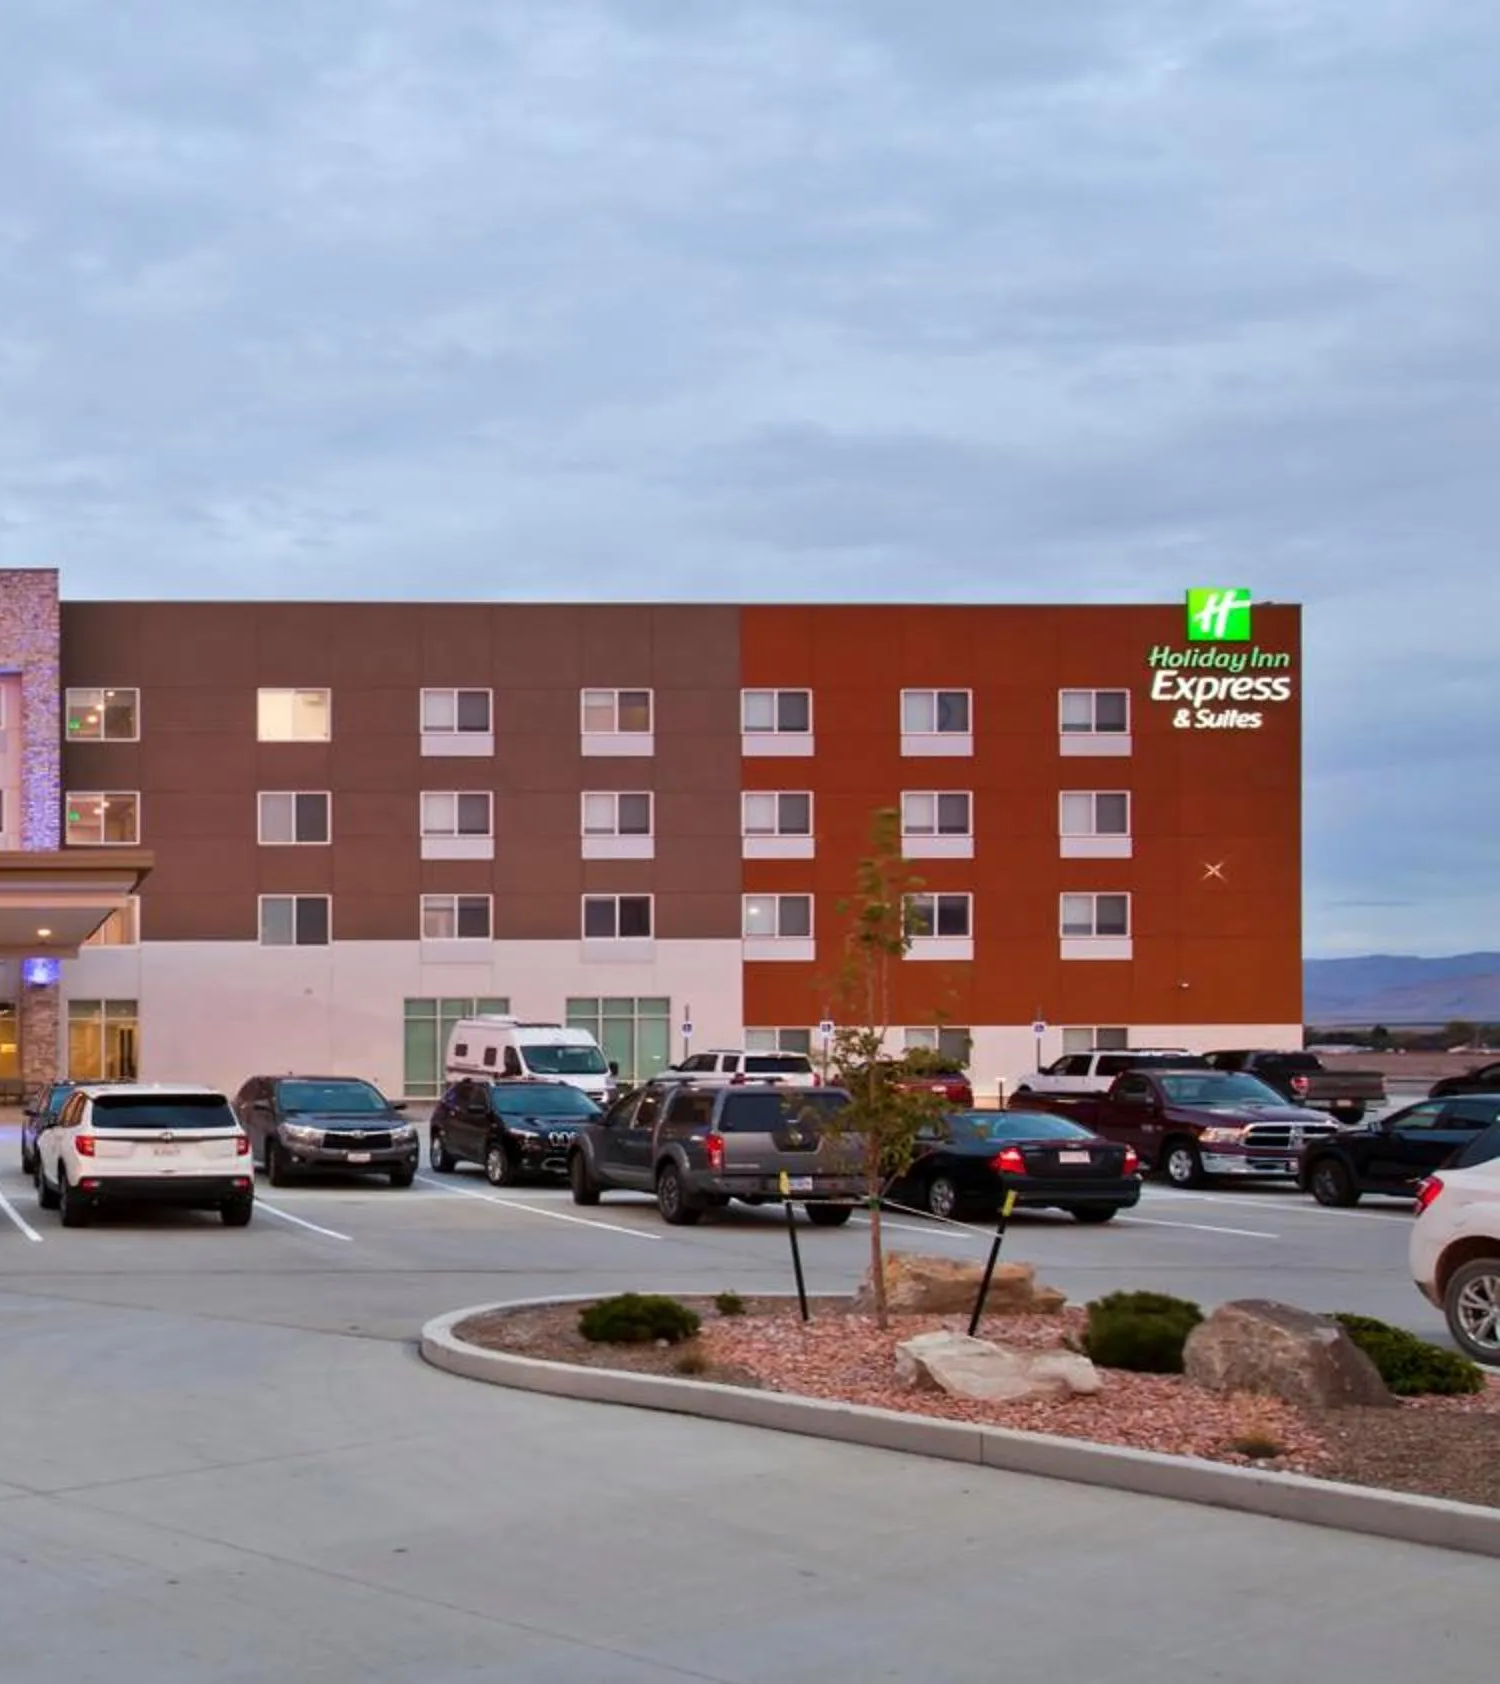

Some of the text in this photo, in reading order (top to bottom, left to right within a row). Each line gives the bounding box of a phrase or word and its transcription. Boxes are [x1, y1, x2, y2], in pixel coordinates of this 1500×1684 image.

[1148, 645, 1290, 672] Holiday Inn
[1150, 670, 1291, 708] Express
[1172, 708, 1262, 728] & Suites
